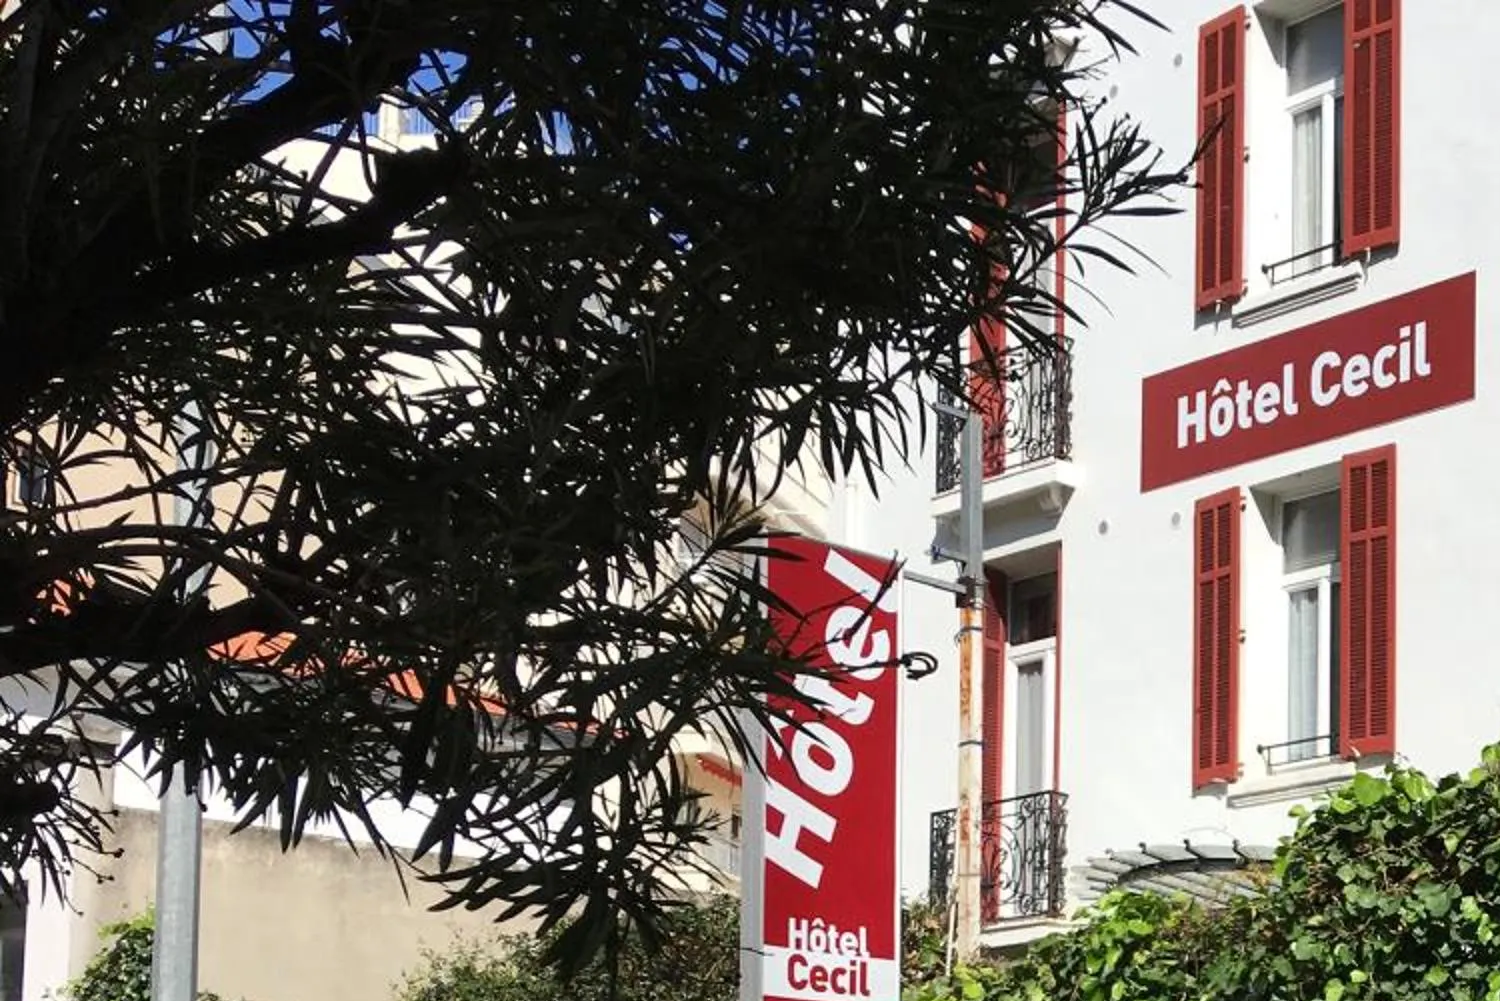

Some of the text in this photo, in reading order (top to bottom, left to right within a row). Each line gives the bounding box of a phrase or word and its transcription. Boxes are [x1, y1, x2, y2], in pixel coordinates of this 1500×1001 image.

[1177, 321, 1431, 449] Hôtel Cecil
[763, 548, 898, 890] Hôtel
[787, 953, 871, 997] Cecil
[788, 917, 870, 958] Hôtel
